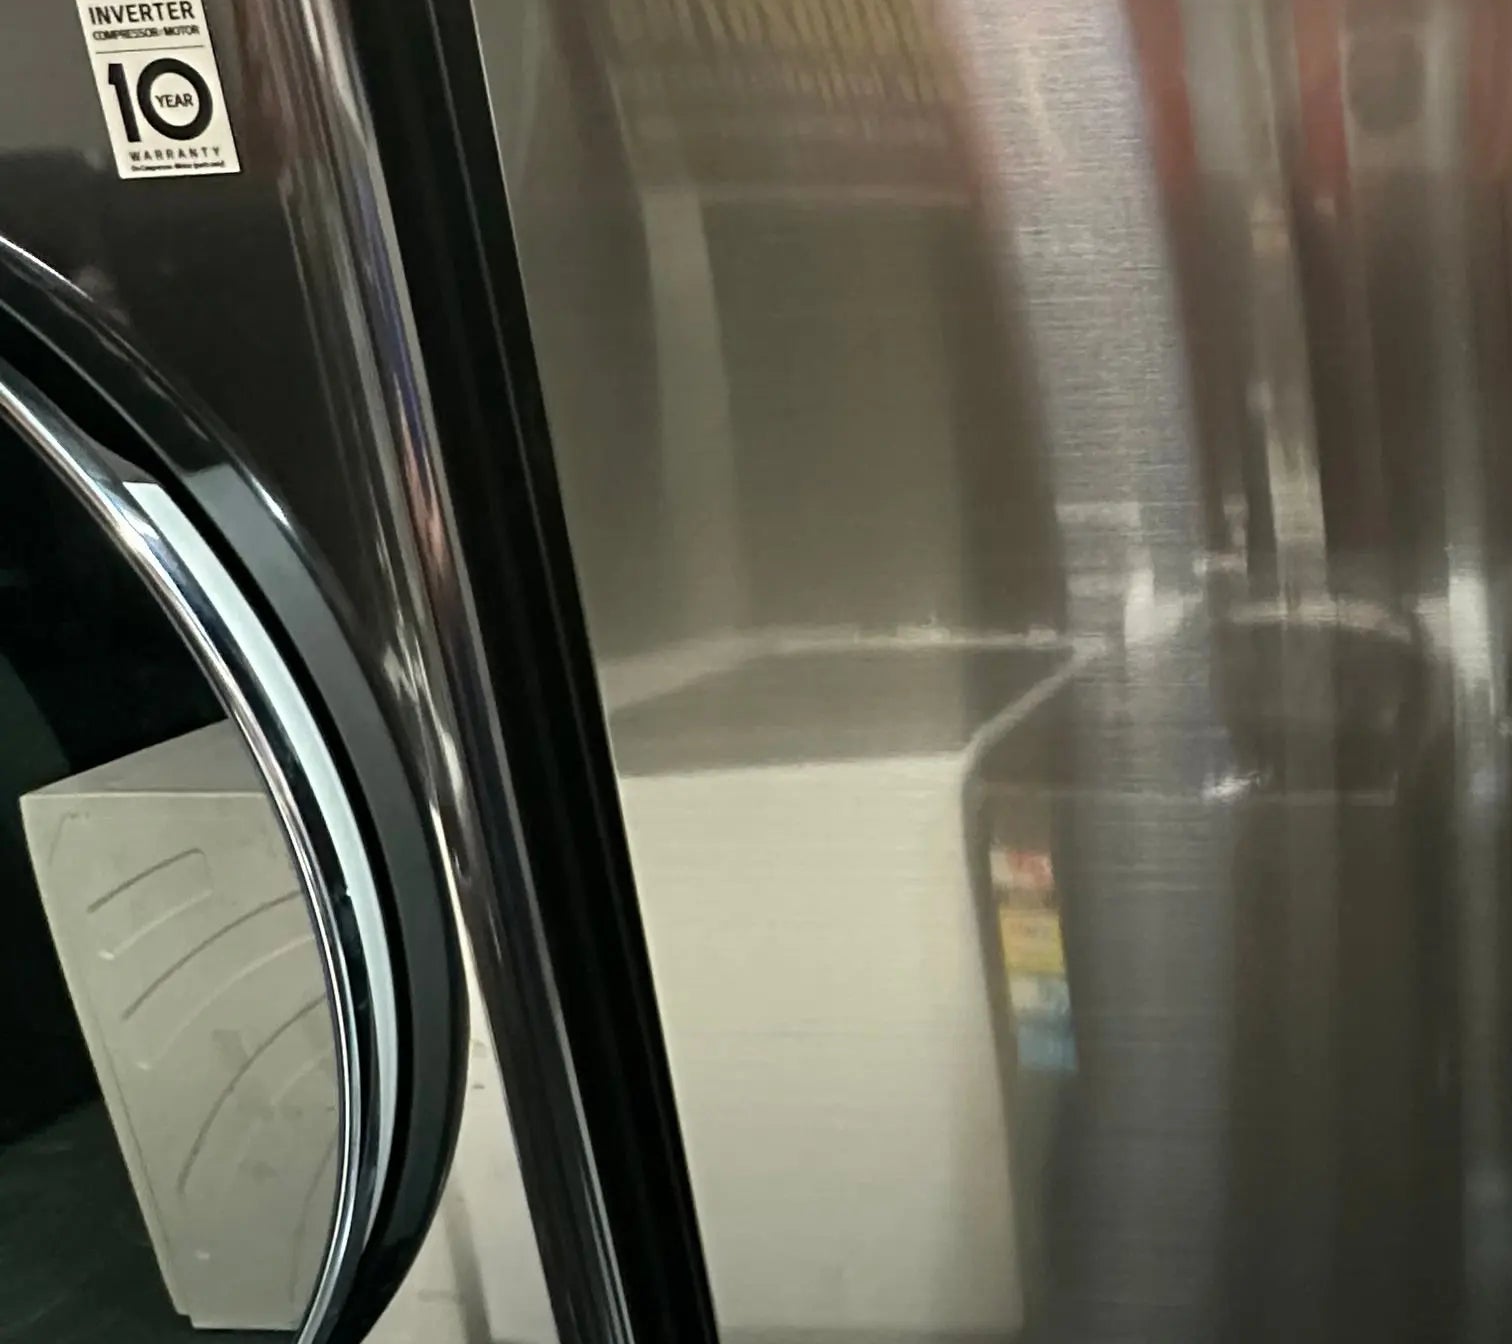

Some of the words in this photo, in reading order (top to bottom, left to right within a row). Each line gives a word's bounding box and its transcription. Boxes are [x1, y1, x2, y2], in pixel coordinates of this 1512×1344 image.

[88, 0, 195, 26] INVERTER
[107, 56, 214, 143] 10
[154, 92, 195, 108] YEAR
[129, 146, 221, 161] WARRANTY
